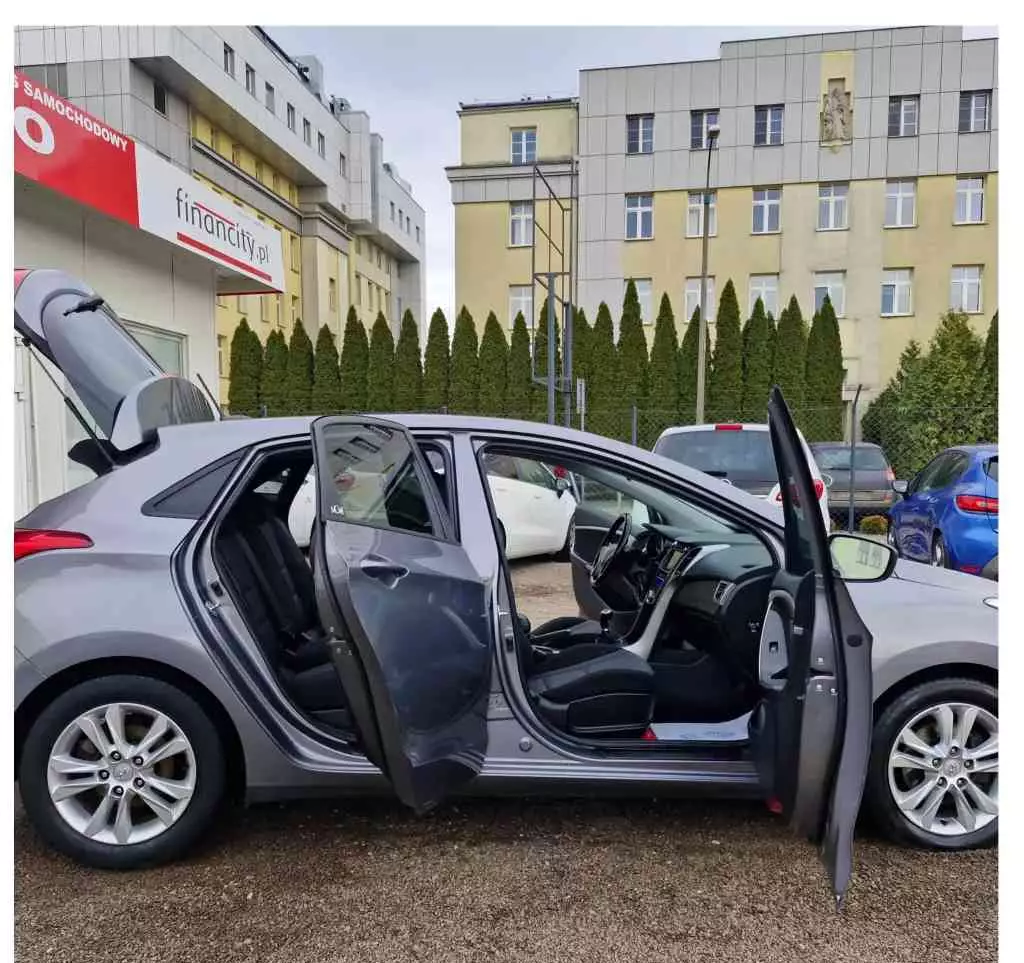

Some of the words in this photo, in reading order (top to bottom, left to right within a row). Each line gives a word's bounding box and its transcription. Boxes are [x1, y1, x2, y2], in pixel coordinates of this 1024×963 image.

[14, 106, 55, 154] O
[23, 80, 128, 152] SAMOCHODOWY
[176, 187, 269, 264] financity.pl
